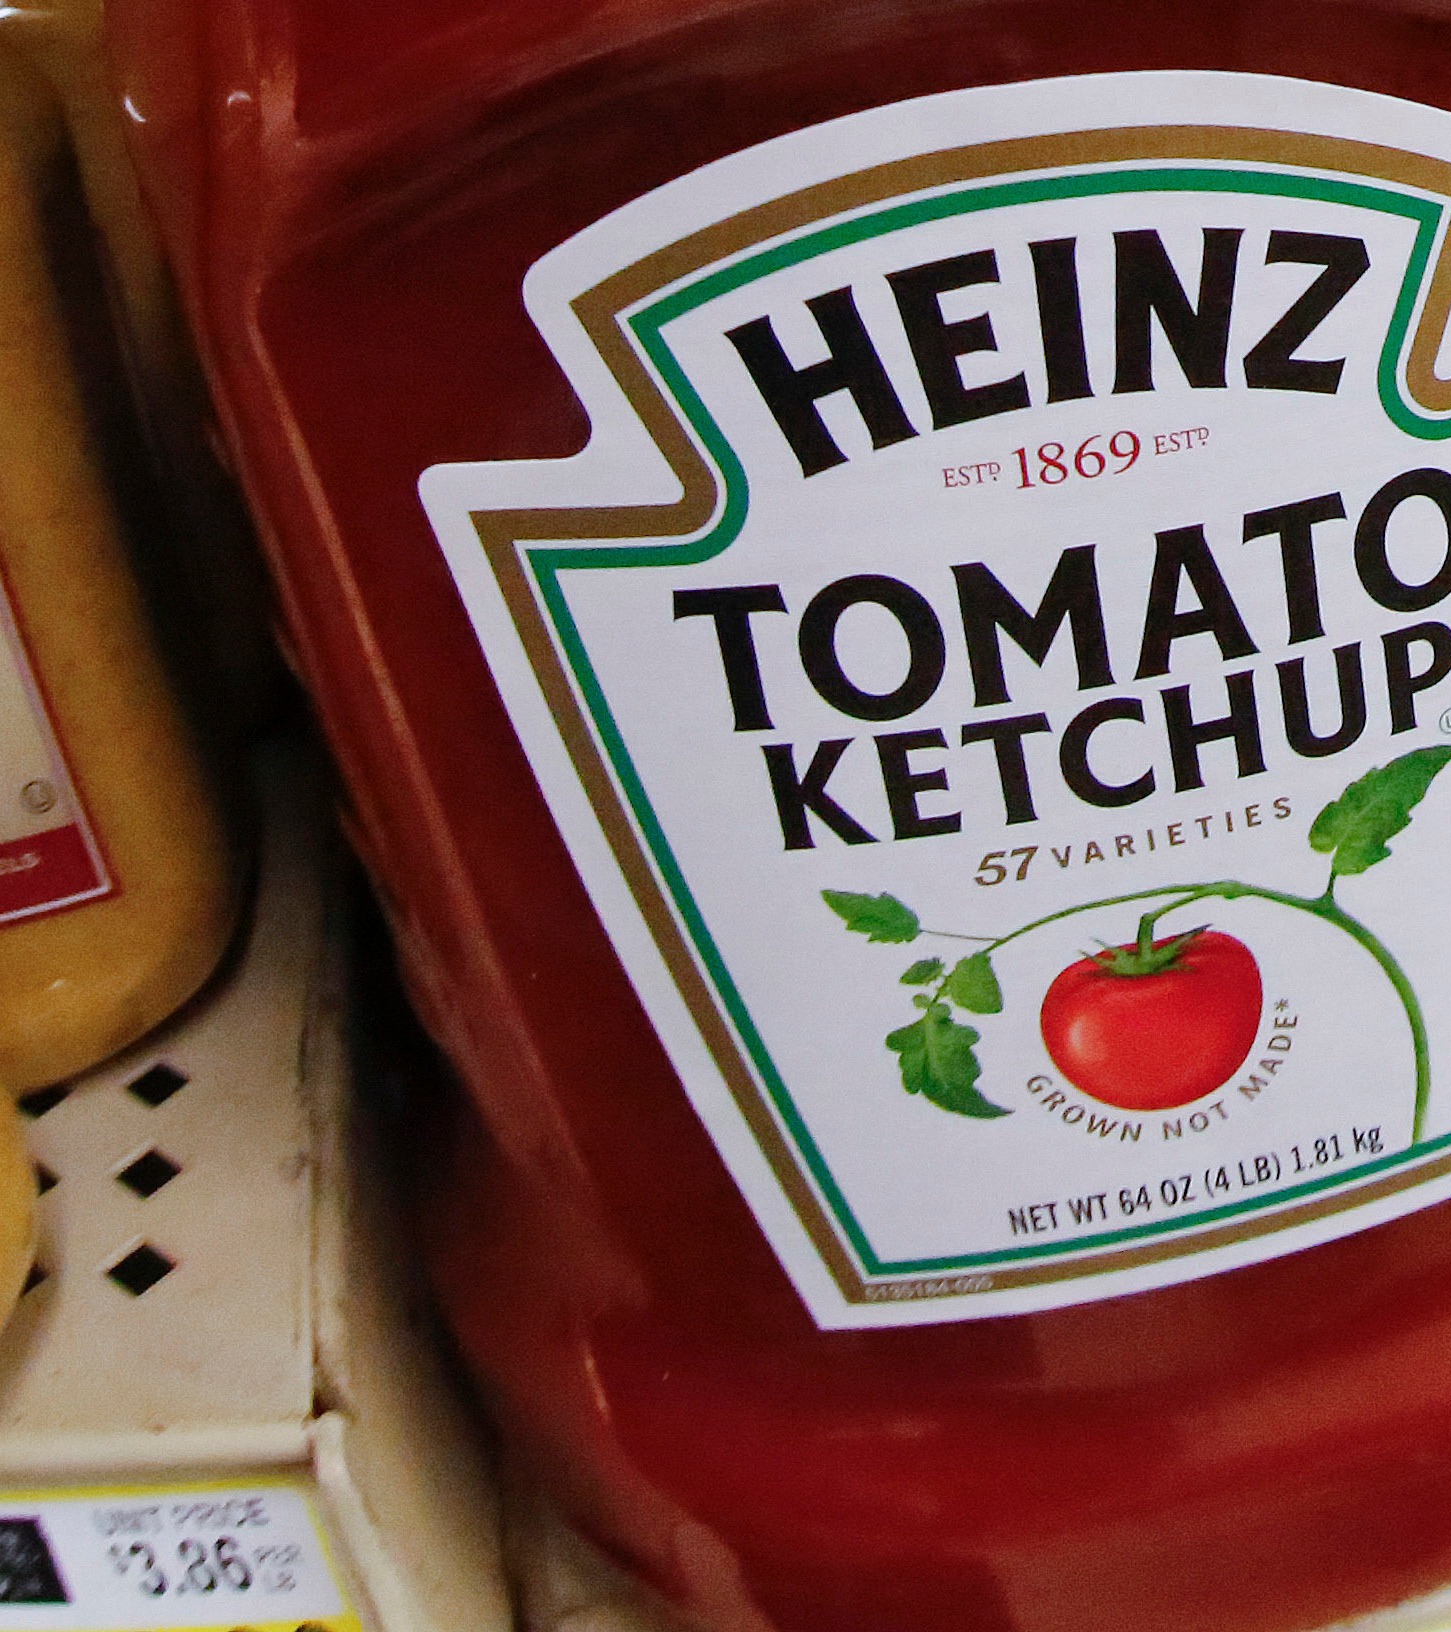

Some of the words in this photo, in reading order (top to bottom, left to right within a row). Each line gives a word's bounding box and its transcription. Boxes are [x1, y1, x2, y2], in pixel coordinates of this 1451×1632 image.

[722, 226, 1372, 480] HEINZ
[1010, 430, 1142, 489] 1869
[973, 844, 1039, 887] 57
[1050, 796, 1293, 869] VARIETIES
[1025, 1073, 1143, 1143] GROWN
[1161, 1099, 1230, 1141] NOT
[1007, 1202, 1060, 1237] NET
[1067, 1192, 1109, 1225] WT
[1118, 1185, 1152, 1217] 64
[1159, 1174, 1197, 1208] OZ
[1203, 1168, 1232, 1199] (4
[1239, 1151, 1283, 1188] LB)
[1290, 1134, 1346, 1175] 1.81
[1351, 1124, 1385, 1154] kg
